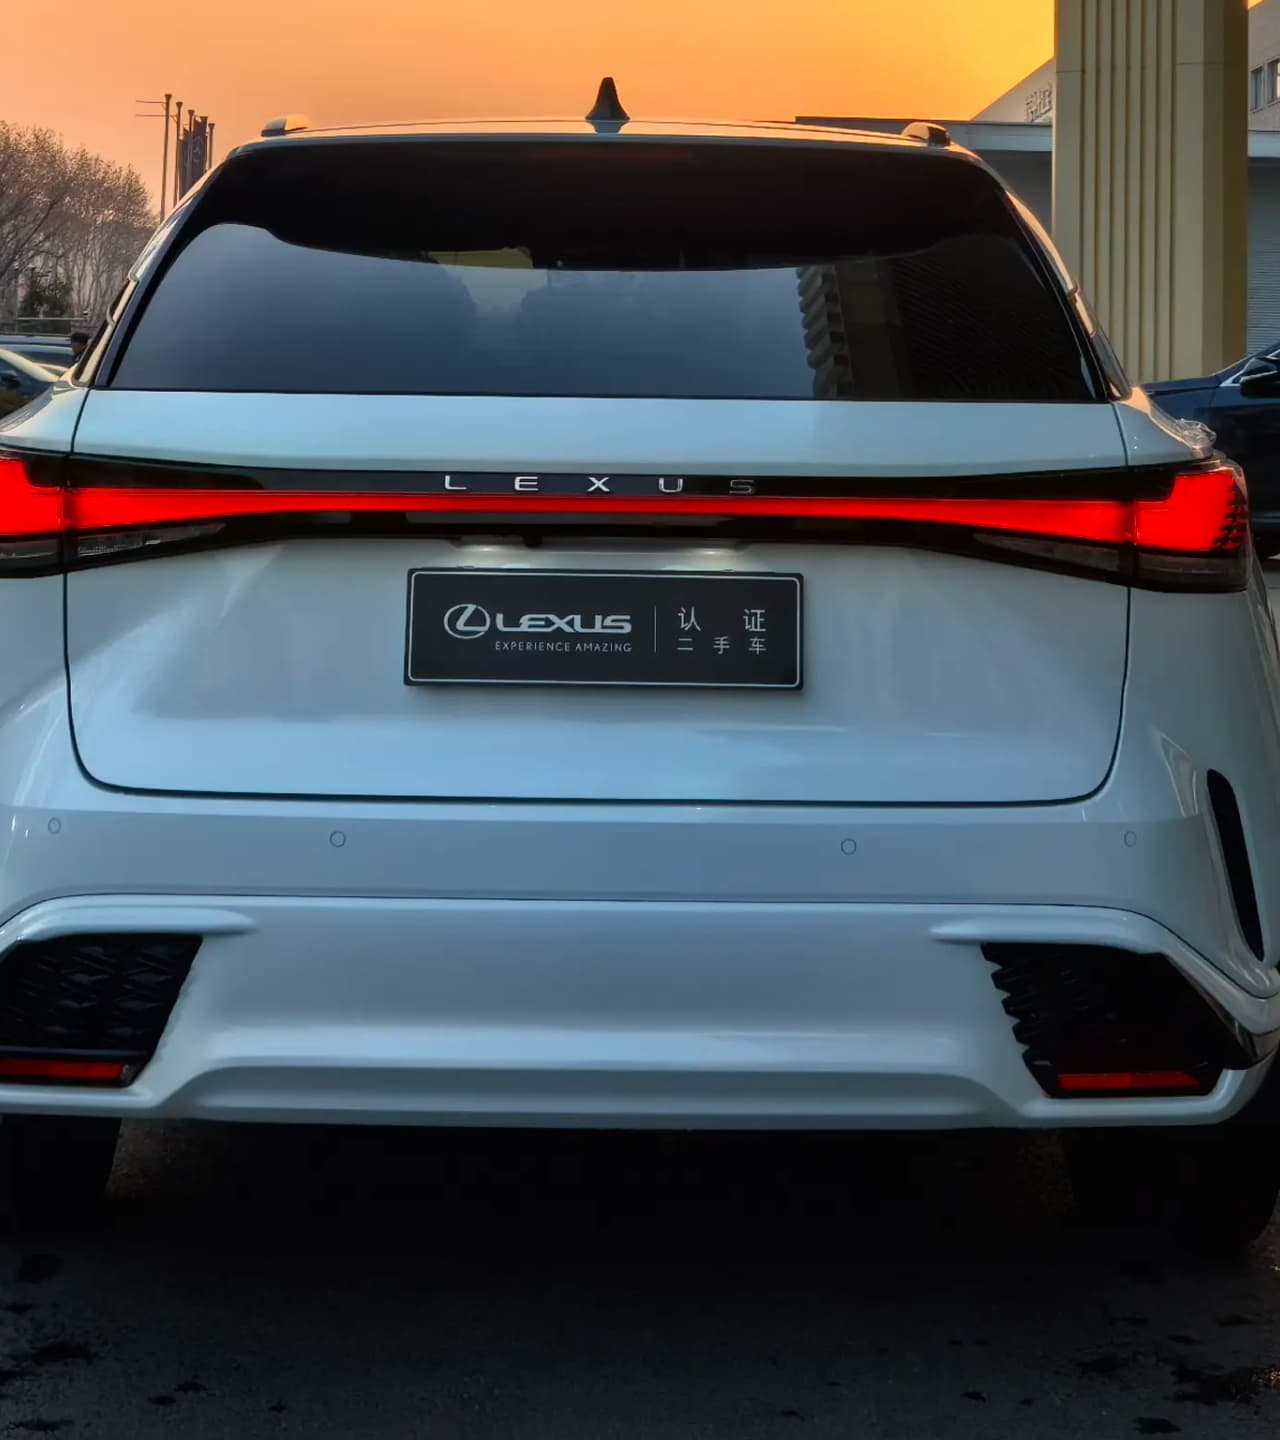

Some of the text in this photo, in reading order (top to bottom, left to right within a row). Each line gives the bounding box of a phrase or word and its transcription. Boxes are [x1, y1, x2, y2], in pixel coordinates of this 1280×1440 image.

[444, 474, 756, 495] LEXUS
[495, 612, 632, 634] LEXUS
[677, 606, 766, 632] 认证
[495, 640, 632, 653] EXPERIENCE AMAZING
[676, 635, 767, 655] 二手车
